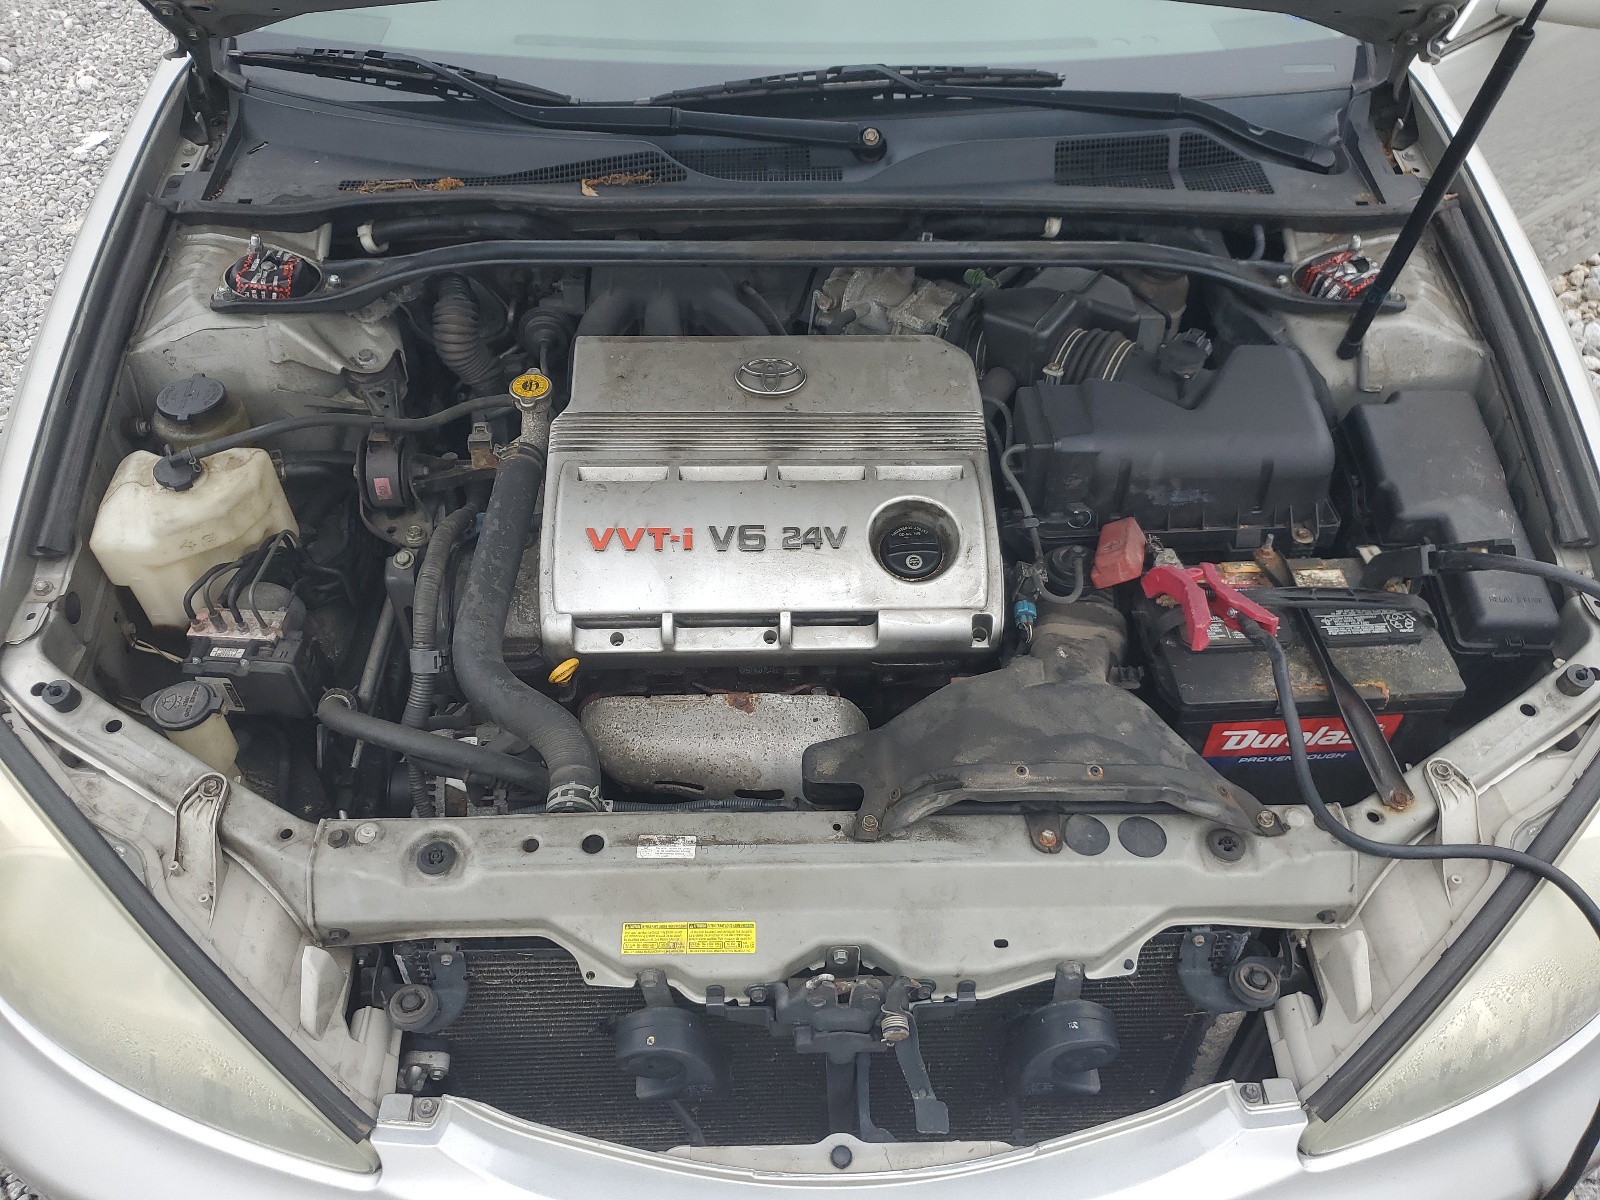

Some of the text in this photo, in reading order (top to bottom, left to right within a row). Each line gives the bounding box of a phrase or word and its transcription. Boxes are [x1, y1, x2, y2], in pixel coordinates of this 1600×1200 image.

[585, 525, 848, 551] VVT-i V6 24V
[1221, 724, 1386, 750] Durla
[1238, 752, 1347, 763] PROVEN OUGH
